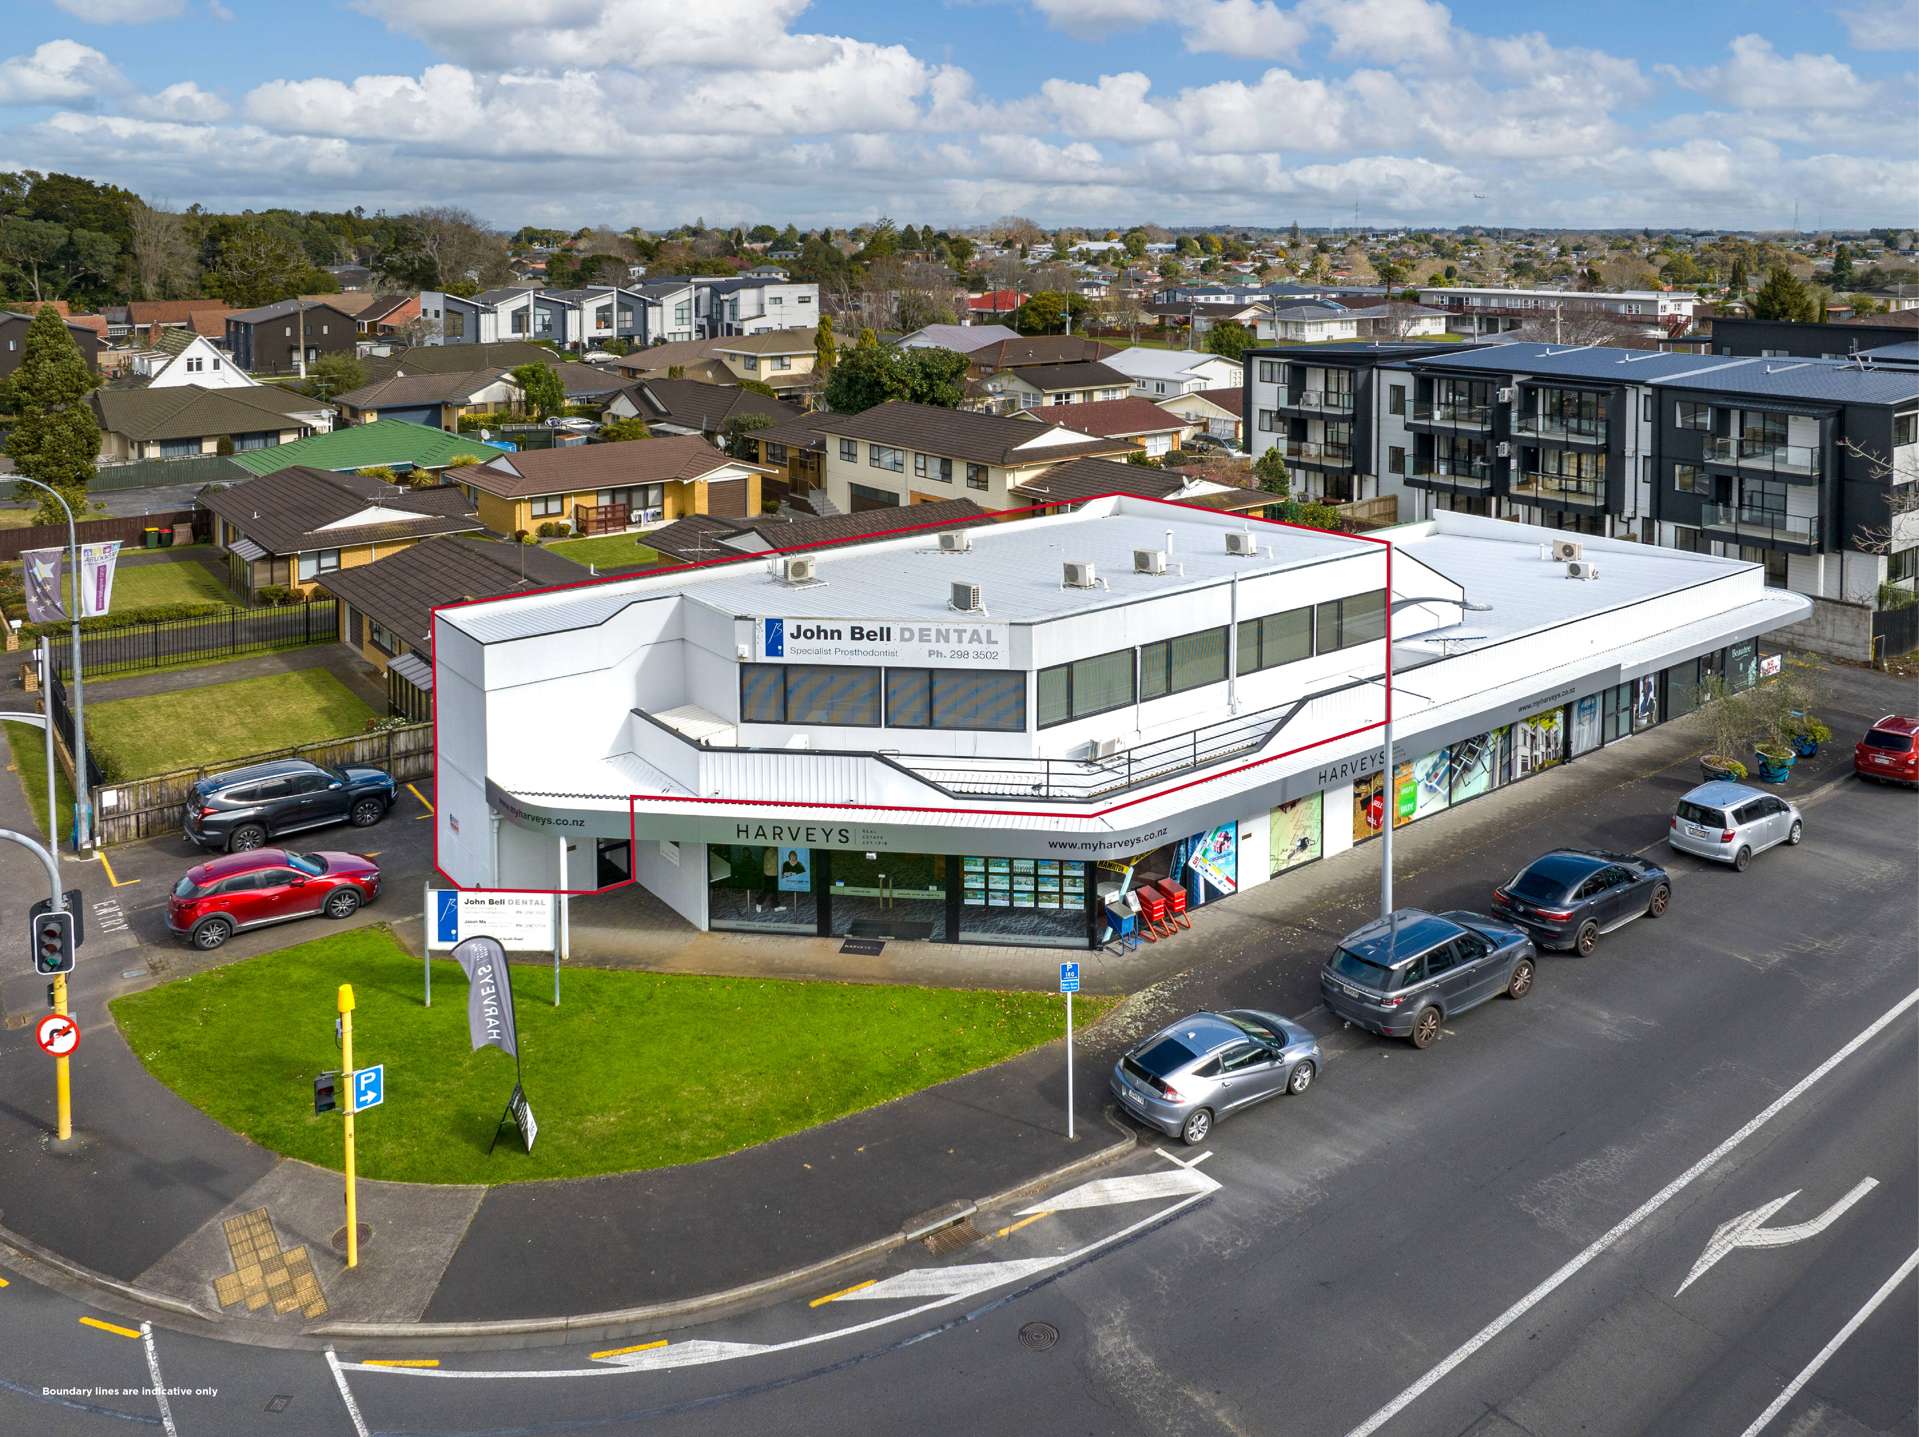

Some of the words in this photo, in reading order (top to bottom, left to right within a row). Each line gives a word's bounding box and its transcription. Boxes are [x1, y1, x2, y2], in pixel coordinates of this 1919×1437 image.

[790, 624, 842, 641] John
[850, 626, 891, 642] Bell
[899, 627, 999, 645] DENTAL
[790, 646, 832, 657] Specialist
[834, 647, 899, 658] Prosthodontist
[928, 649, 947, 659] Ph.
[950, 650, 969, 660] 298
[972, 651, 999, 660] 3502
[1318, 750, 1386, 785] HARVEYS
[736, 823, 850, 844] HARVEYS
[1049, 827, 1168, 852] www.myharveys.co.nz
[464, 898, 486, 906] John
[488, 898, 505, 906] Bell
[92, 899, 129, 933] ENTRY
[1066, 964, 1073, 972] P
[360, 1071, 377, 1091] P
